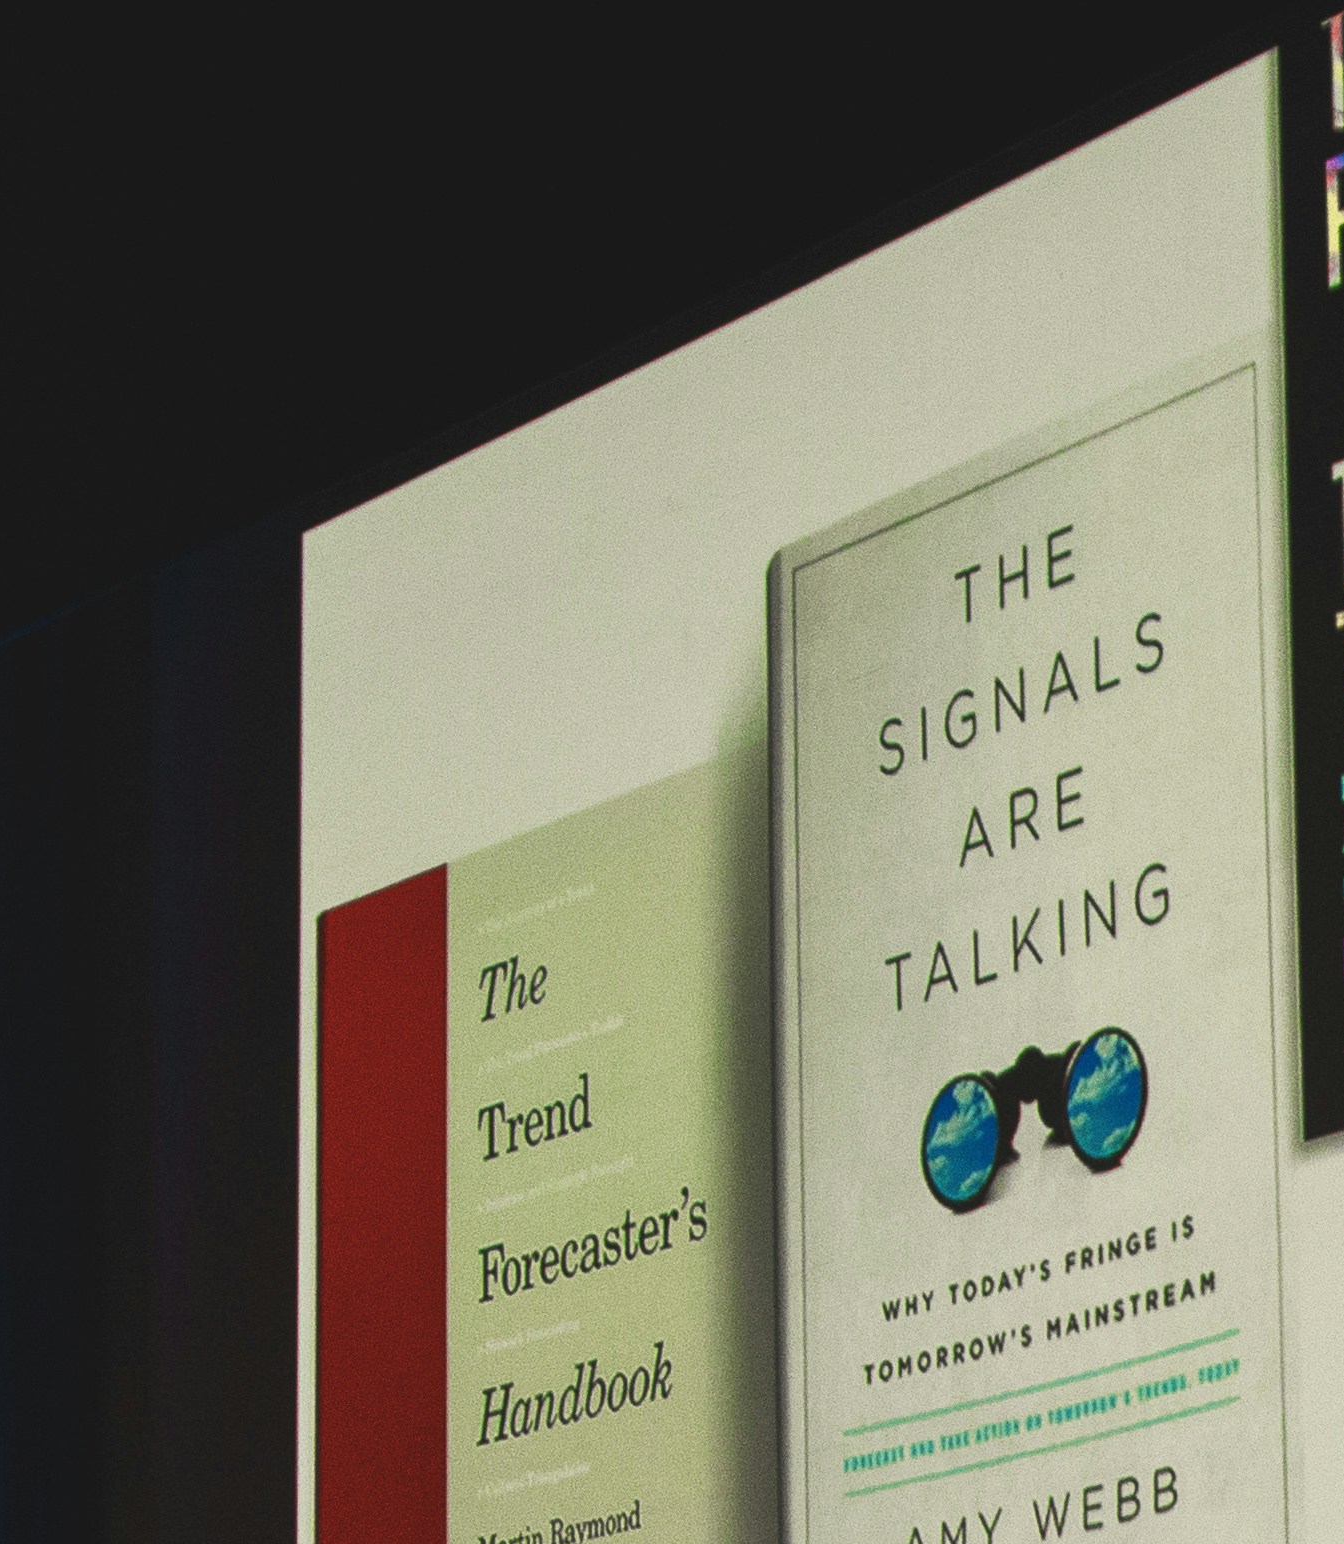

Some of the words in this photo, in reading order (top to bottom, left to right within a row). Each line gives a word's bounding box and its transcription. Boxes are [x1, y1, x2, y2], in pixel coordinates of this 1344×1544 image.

[955, 524, 1075, 623] THE
[879, 612, 1164, 776] SIGNALS
[959, 766, 1084, 868] ARE
[479, 956, 547, 1021] The
[885, 862, 1170, 1011] TALKING
[478, 1073, 592, 1161] Trend
[478, 1187, 707, 1302] Forecaster's
[882, 1291, 934, 1322] WHY
[948, 1259, 1051, 1305] TODAY'S
[1065, 1226, 1157, 1274] FRINGE
[1171, 1215, 1195, 1242] IS
[863, 1324, 1032, 1386] TOMORROW'S
[1046, 1271, 1216, 1341] MAINSTREAM
[477, 1341, 673, 1446] Handbook
[1033, 1466, 1178, 1540] WEBB
